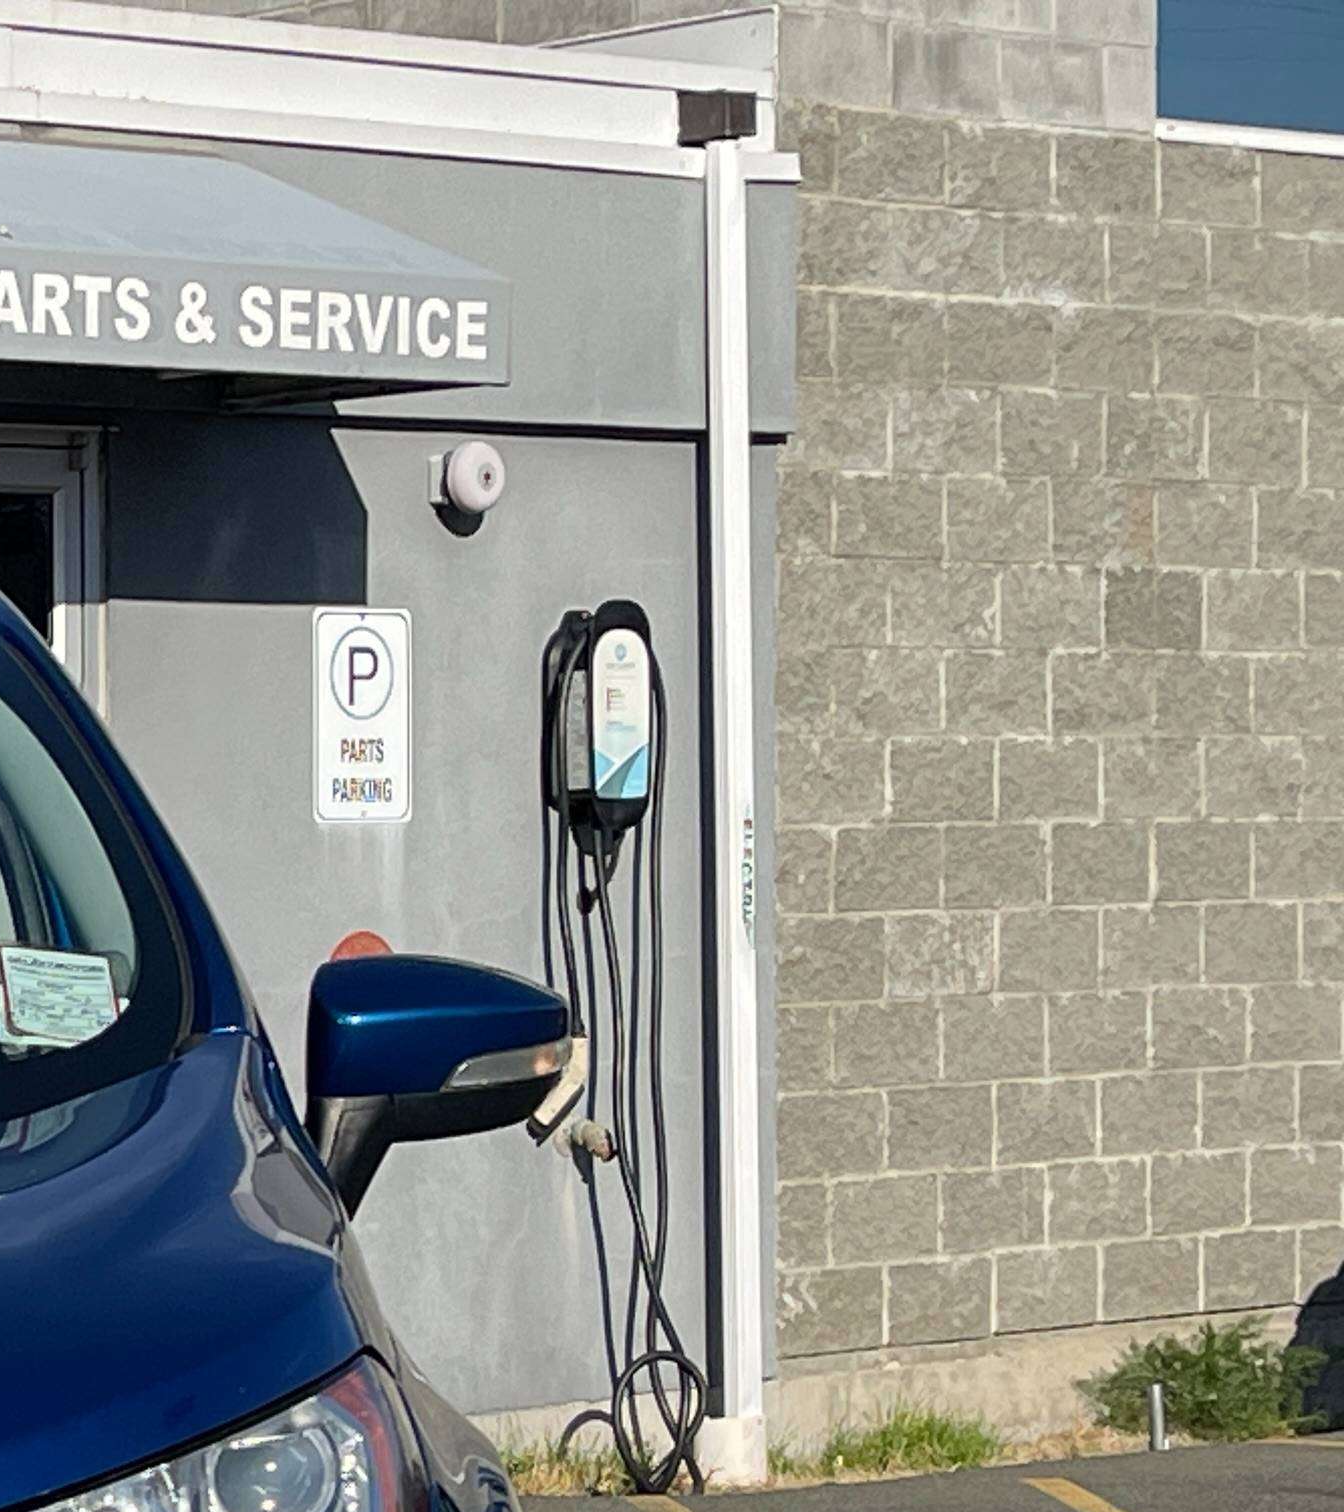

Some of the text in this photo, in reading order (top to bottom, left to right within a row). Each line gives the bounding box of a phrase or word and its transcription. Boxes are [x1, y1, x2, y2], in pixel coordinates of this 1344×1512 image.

[175, 282, 217, 344] &
[240, 285, 487, 360] SERVICE
[349, 646, 378, 706] P
[340, 738, 384, 763] PARTS
[332, 778, 392, 802] PARKING
